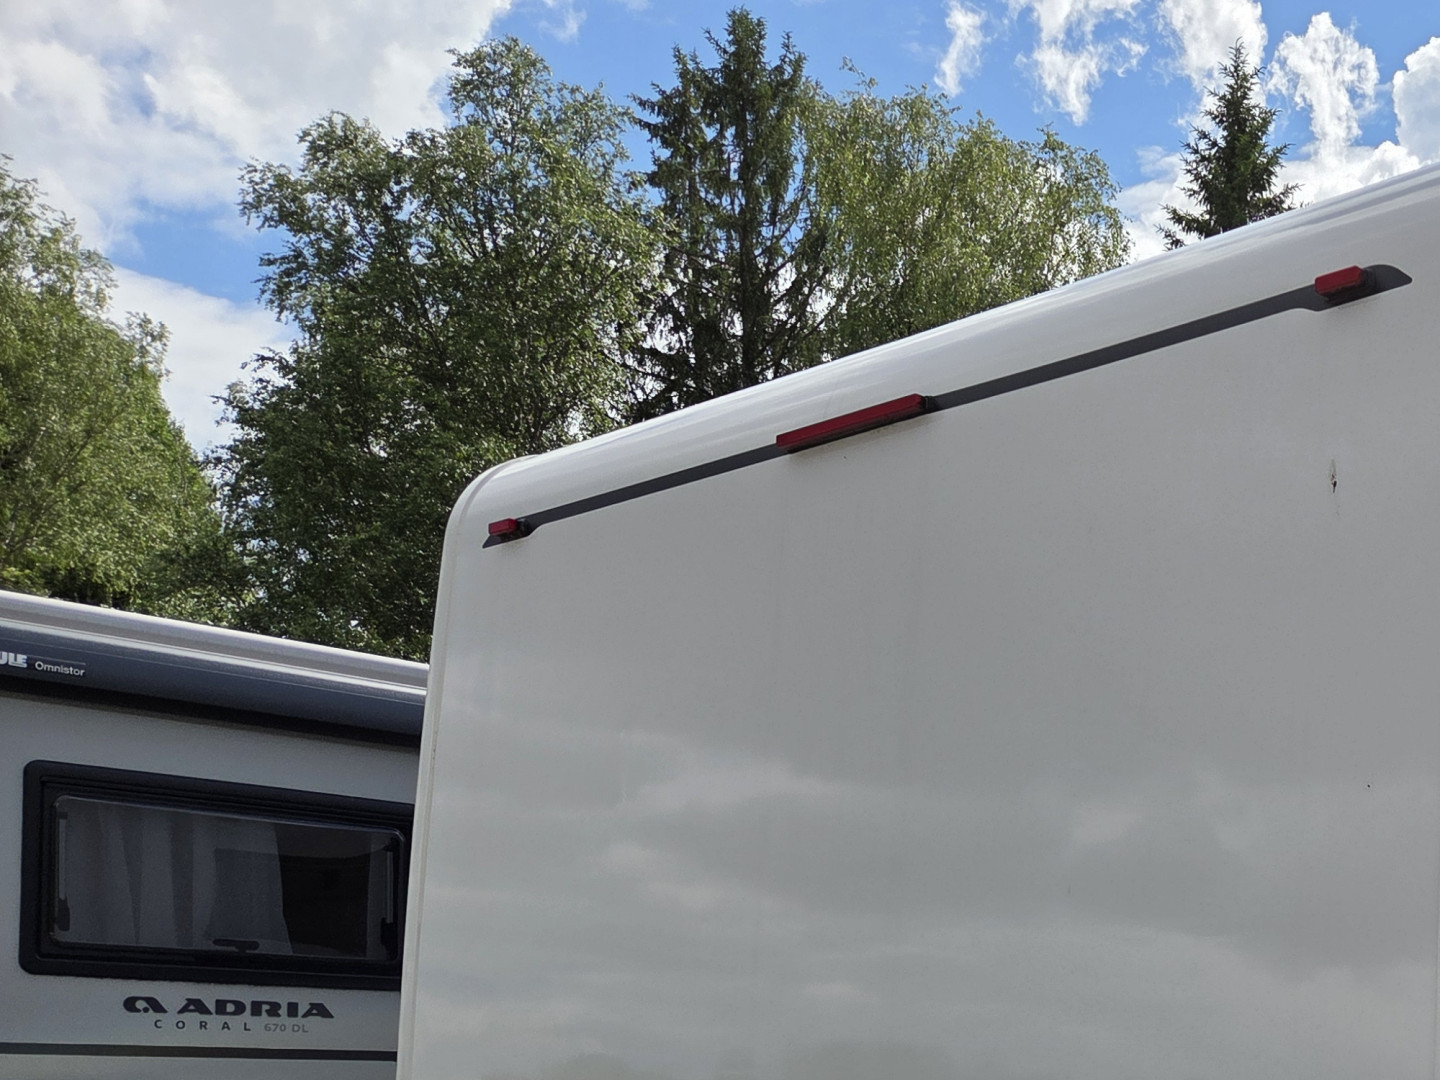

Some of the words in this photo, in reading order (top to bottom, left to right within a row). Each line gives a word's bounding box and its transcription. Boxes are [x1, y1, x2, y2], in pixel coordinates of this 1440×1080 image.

[0, 651, 28, 668] ULE
[35, 661, 85, 676] Omnistor
[177, 997, 335, 1019] ADRIA
[154, 1019, 251, 1032] CORAL
[264, 1023, 286, 1032] 670
[292, 1024, 309, 1033] DL
